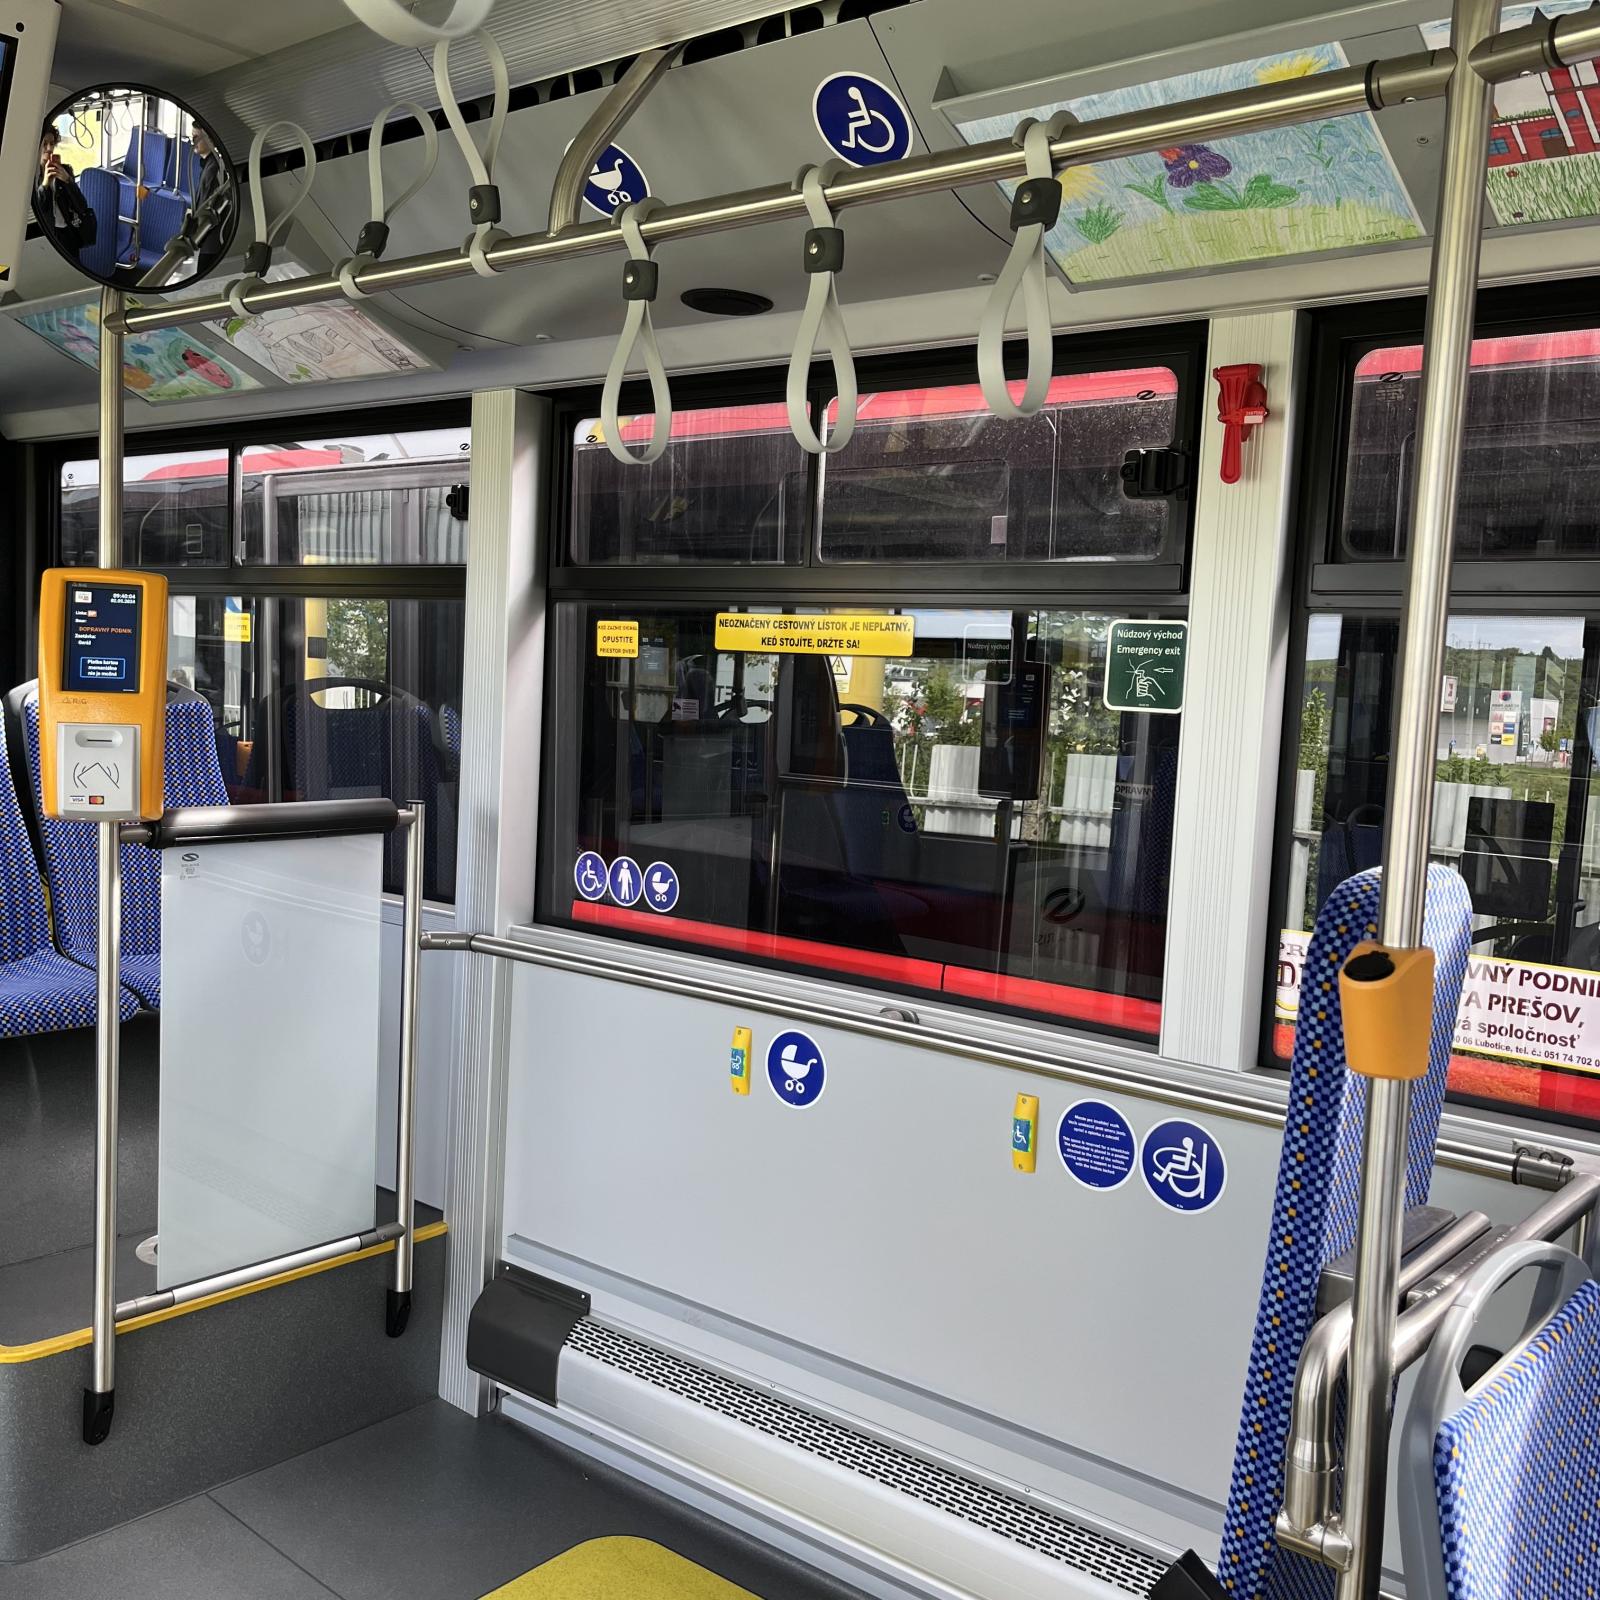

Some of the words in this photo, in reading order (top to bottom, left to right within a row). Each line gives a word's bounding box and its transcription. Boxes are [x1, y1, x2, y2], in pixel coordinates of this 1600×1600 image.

[719, 616, 770, 630] NEOZNAČENÝ
[773, 618, 815, 631] CESTOVNÝ
[817, 619, 847, 632] LÍSTOK
[849, 621, 860, 632] JE
[862, 619, 911, 633] NEPLATNÝ.
[761, 634, 778, 648] KEĎ
[779, 634, 815, 649] STOJÍTE,
[816, 634, 844, 649] DRŽTE
[846, 638, 860, 650] SA!
[1117, 628, 1151, 640] Núdzový
[1154, 629, 1183, 641] východ
[1117, 644, 1163, 657] Emergency
[1165, 646, 1181, 656] exit
[1463, 990, 1482, 1009] A
[1488, 993, 1585, 1028] PREŠOV,
[1477, 1022, 1580, 1048] spoločnosť
[1462, 1036, 1472, 1045] 06
[1515, 1045, 1529, 1055] tel.
[1544, 1050, 1559, 1060] 051
[1563, 1054, 1574, 1062] 74
[1576, 1055, 1592, 1066] 702
